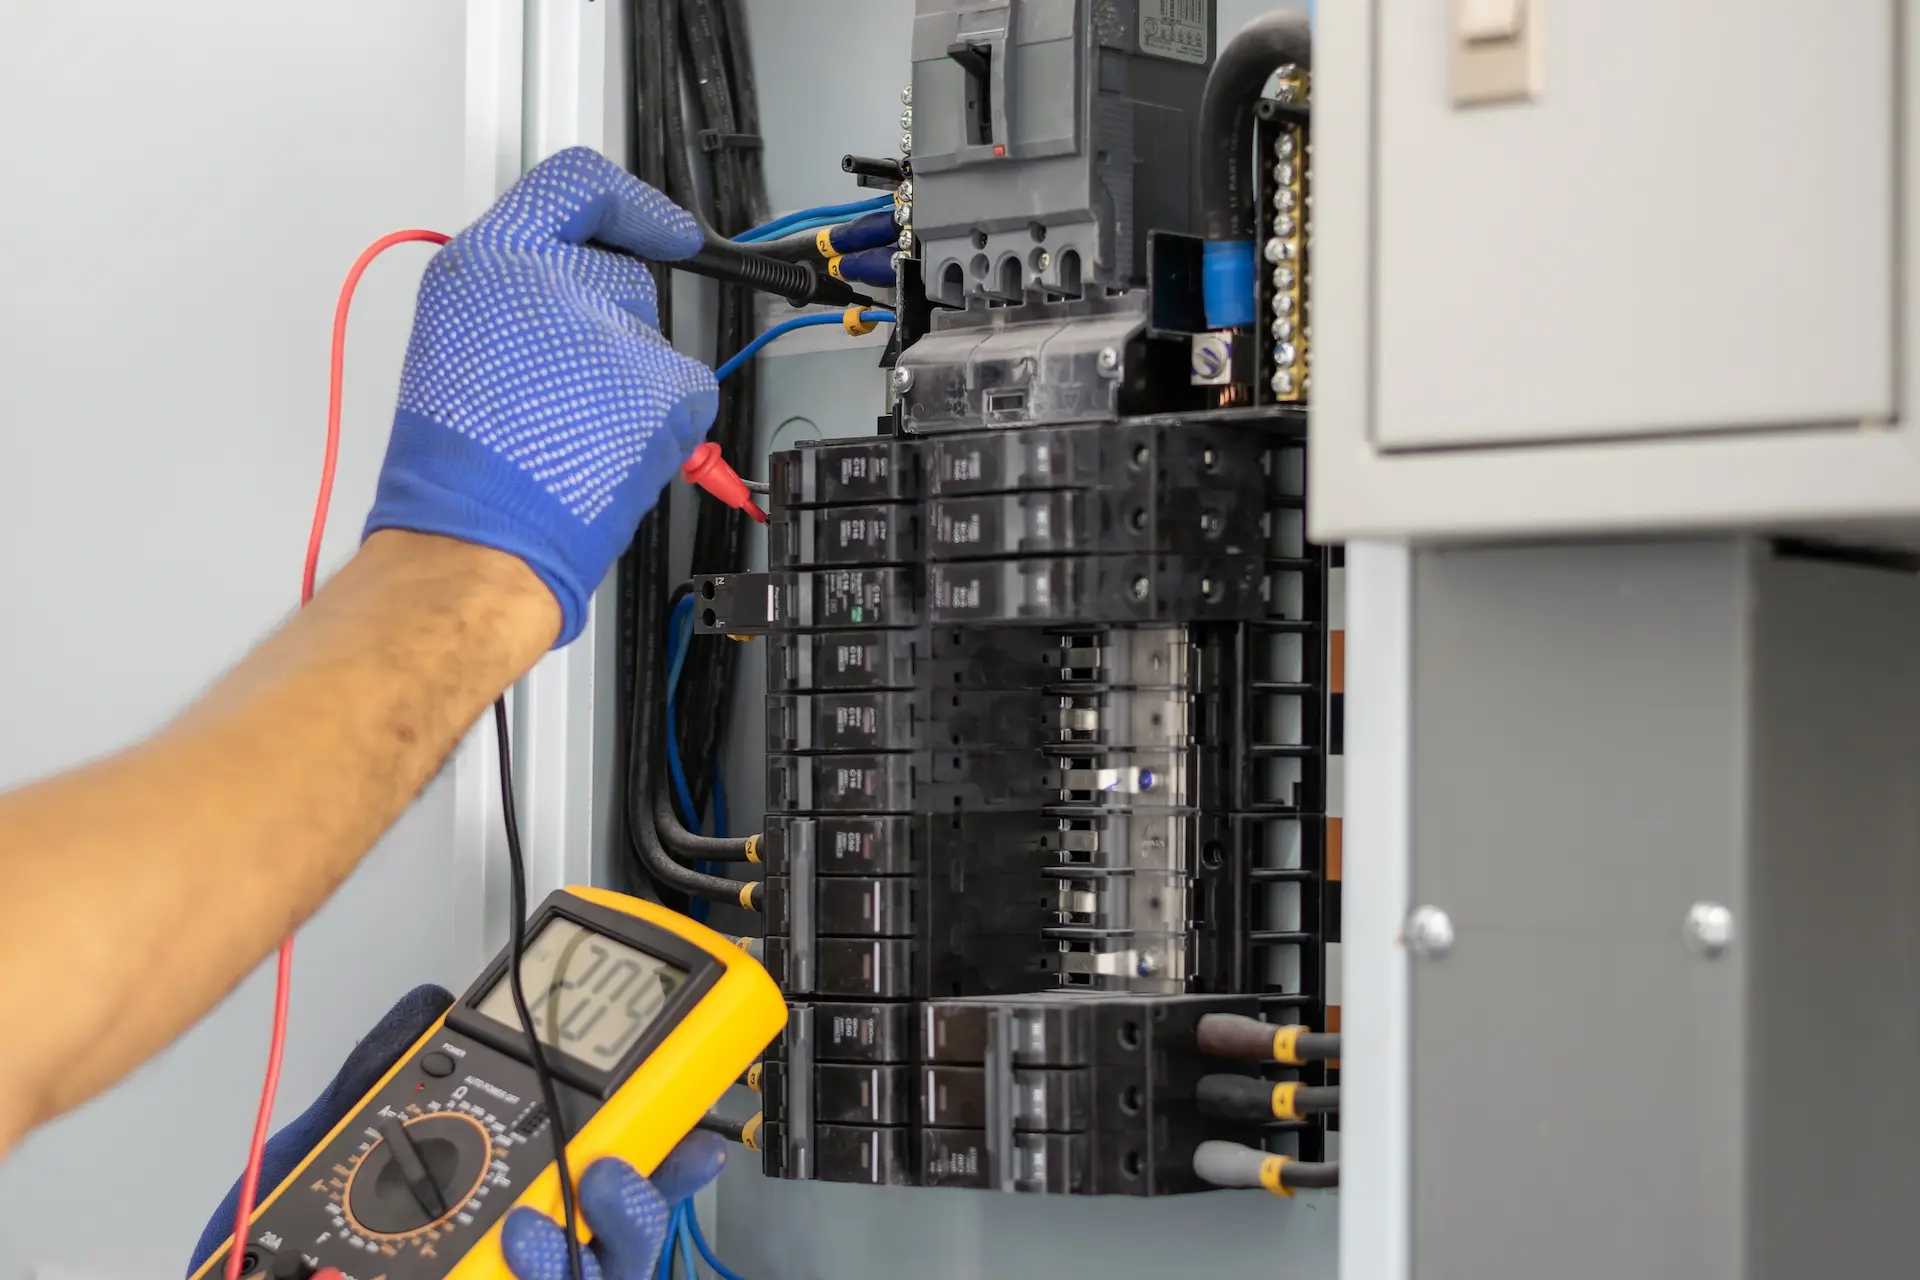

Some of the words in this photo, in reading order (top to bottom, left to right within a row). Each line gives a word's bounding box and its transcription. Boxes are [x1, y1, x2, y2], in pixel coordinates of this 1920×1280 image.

[819, 240, 827, 252] 2
[832, 265, 839, 277] 3
[850, 326, 859, 335] 5
[442, 1042, 467, 1058] POWER
[750, 1074, 756, 1085] 3
[258, 1231, 283, 1250] 20A
